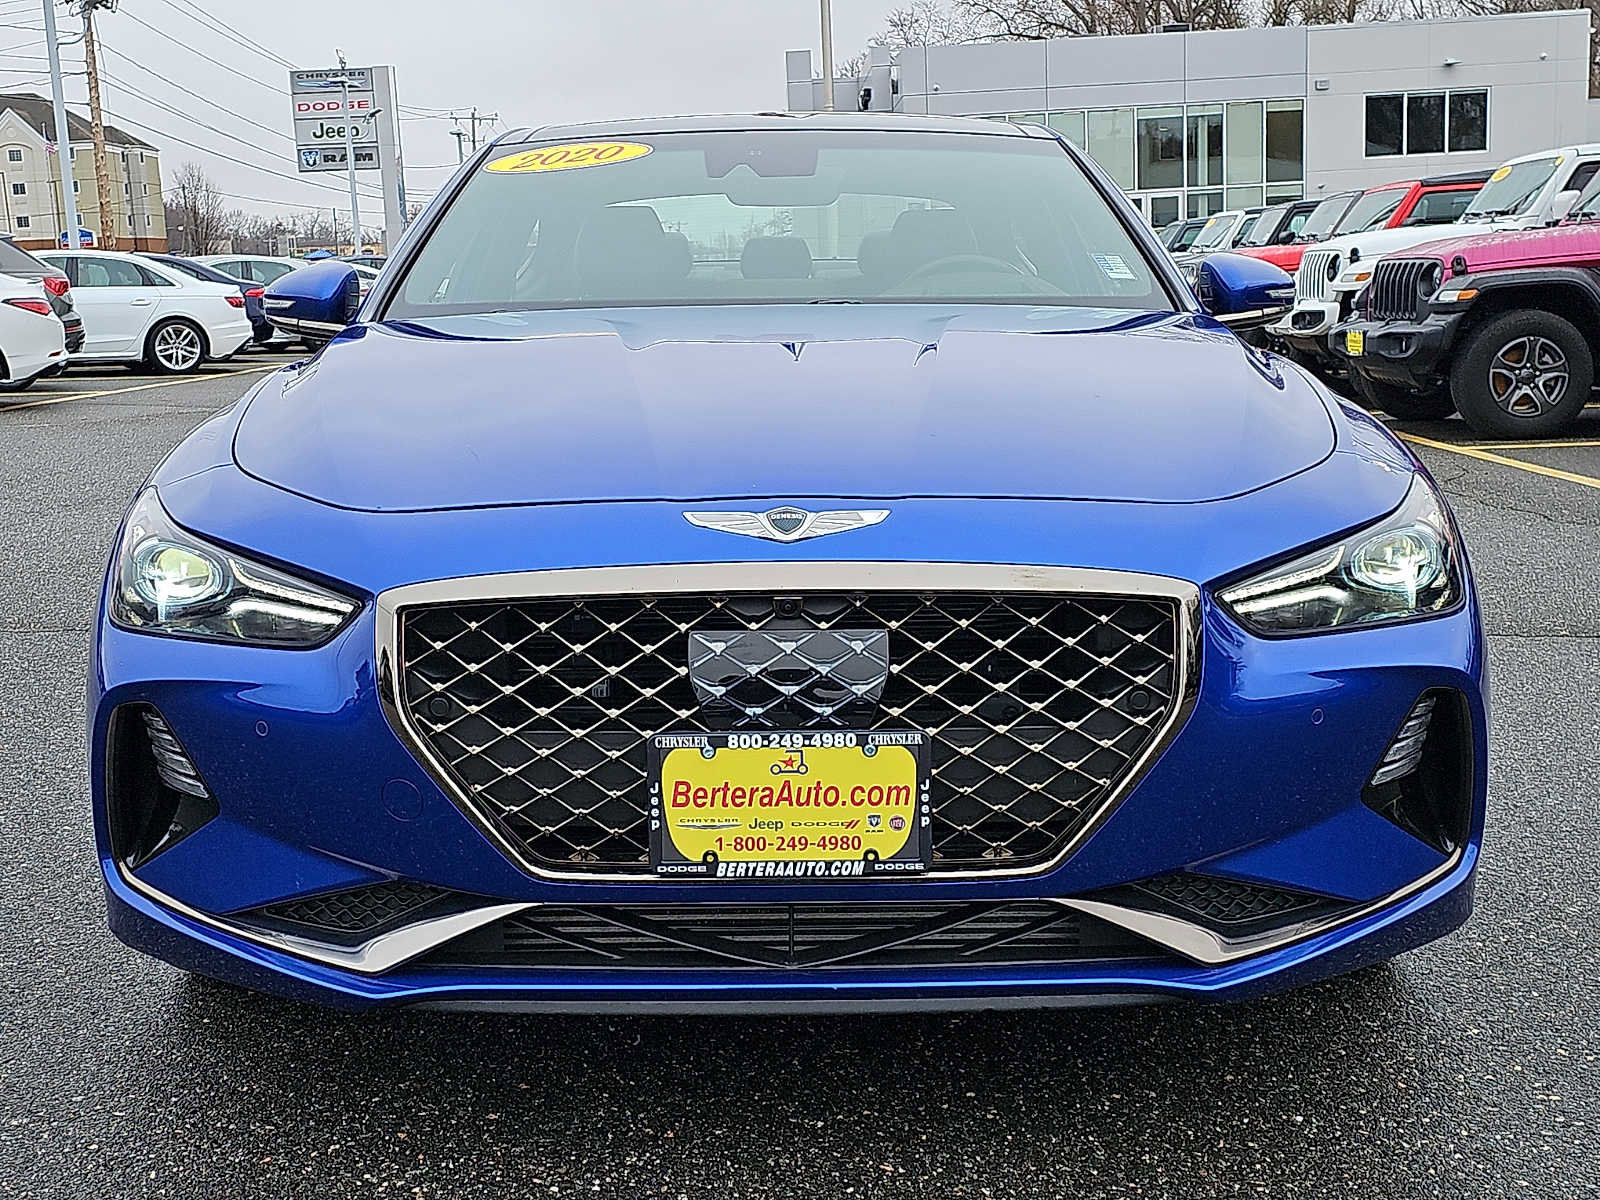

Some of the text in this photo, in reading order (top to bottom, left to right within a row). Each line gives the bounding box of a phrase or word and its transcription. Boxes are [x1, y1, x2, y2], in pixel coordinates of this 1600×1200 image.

[298, 101, 369, 112] DODGE
[510, 146, 624, 169] 2020
[654, 736, 709, 748] CHRYSLER
[727, 733, 856, 748] 800-249-4980
[868, 733, 923, 745] CHRYSLER
[672, 780, 910, 808] BerteraAuto.com
[650, 782, 660, 830] Jeep
[920, 779, 930, 827] Jeep
[748, 818, 784, 832] Jeep
[715, 836, 862, 851] 1-800-249-4980
[716, 861, 864, 877] BERTERAAUTO.COM
